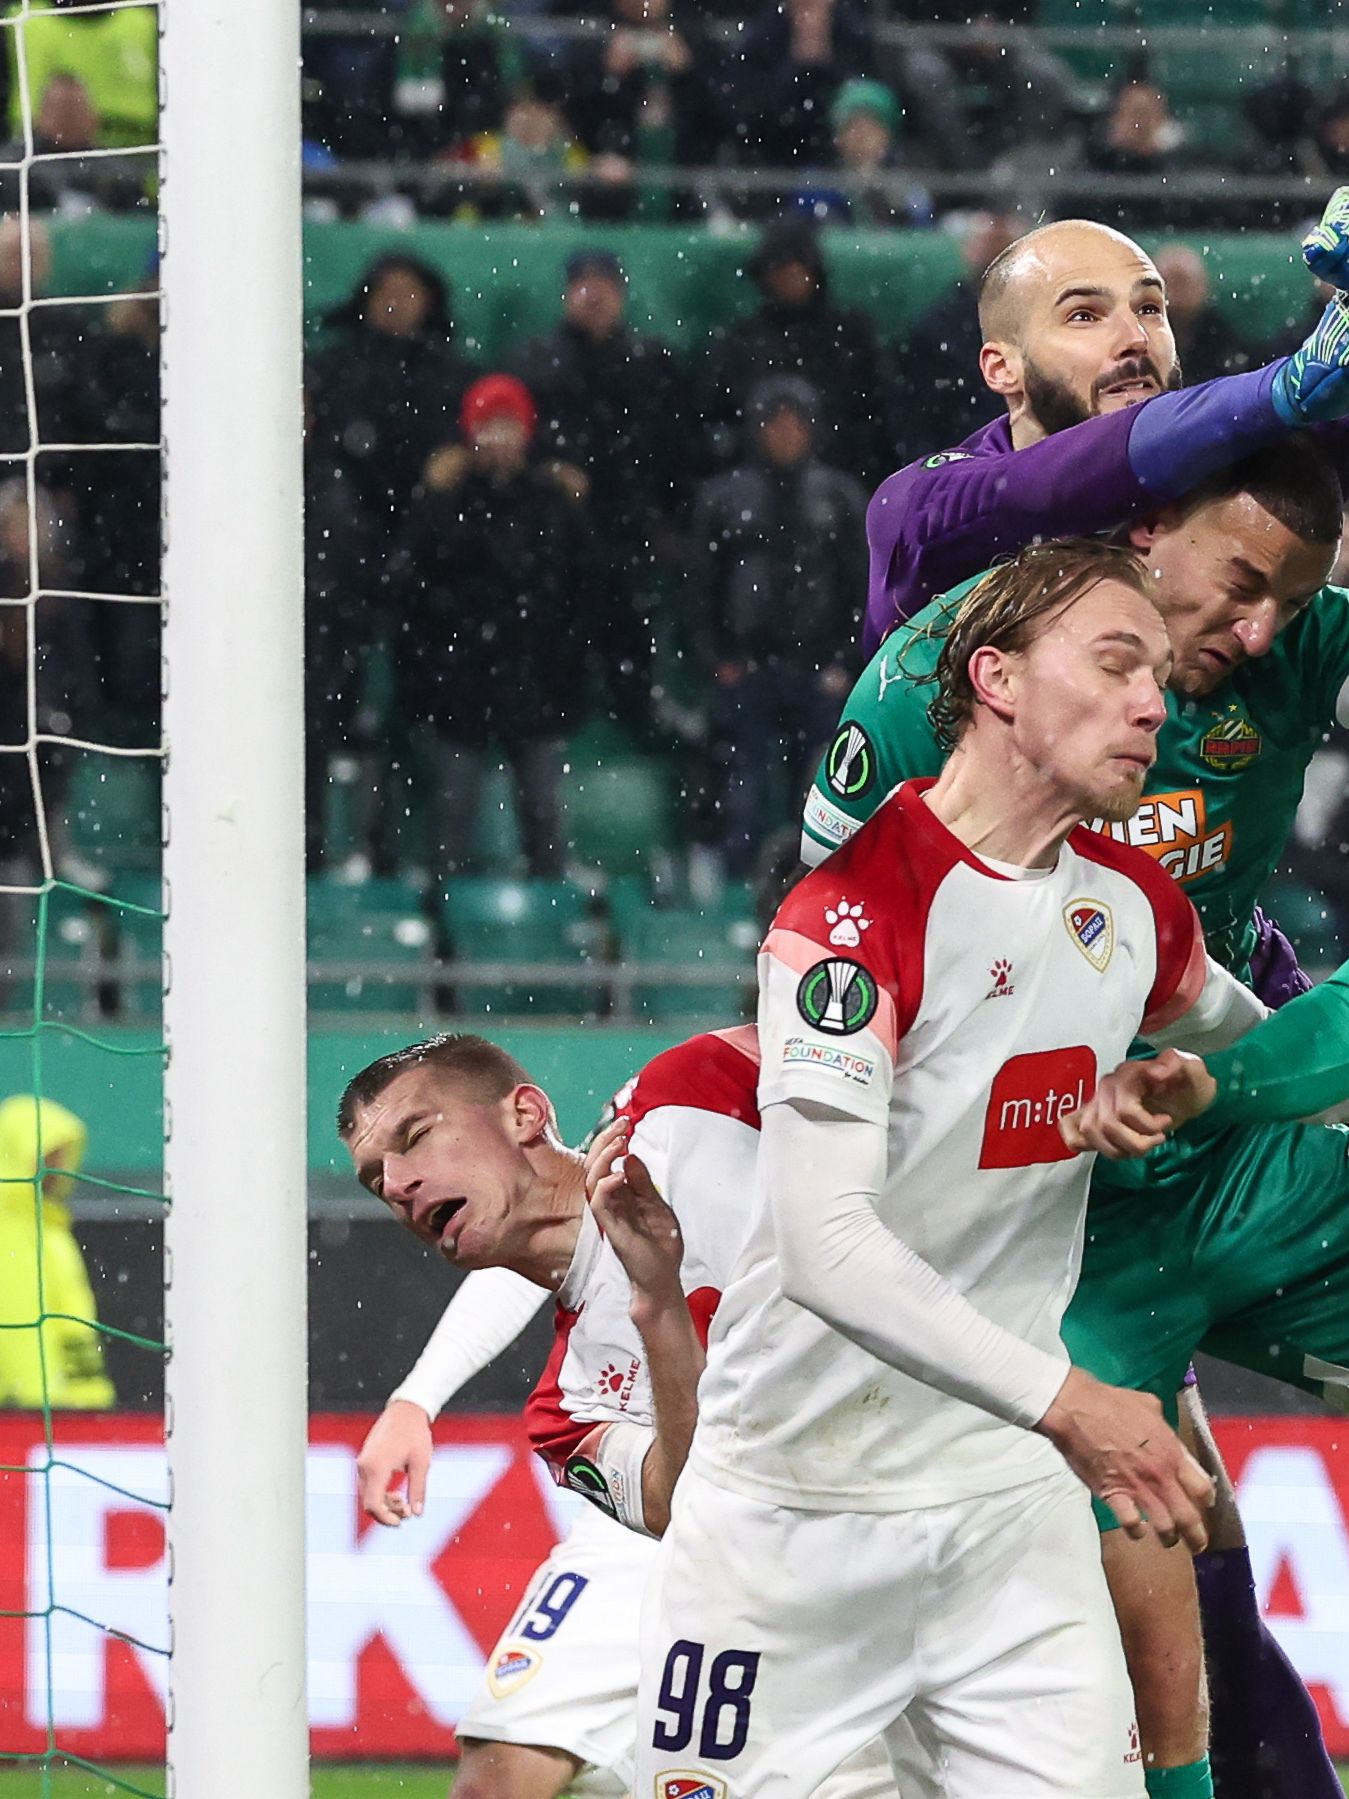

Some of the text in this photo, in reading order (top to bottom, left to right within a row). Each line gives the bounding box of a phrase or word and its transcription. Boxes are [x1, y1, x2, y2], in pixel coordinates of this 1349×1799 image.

[783, 1046, 875, 1078] FOUNDATION
[999, 1078, 1084, 1131] m:tel
[619, 1359, 641, 1412] KELME
[653, 1639, 761, 1761] 98
